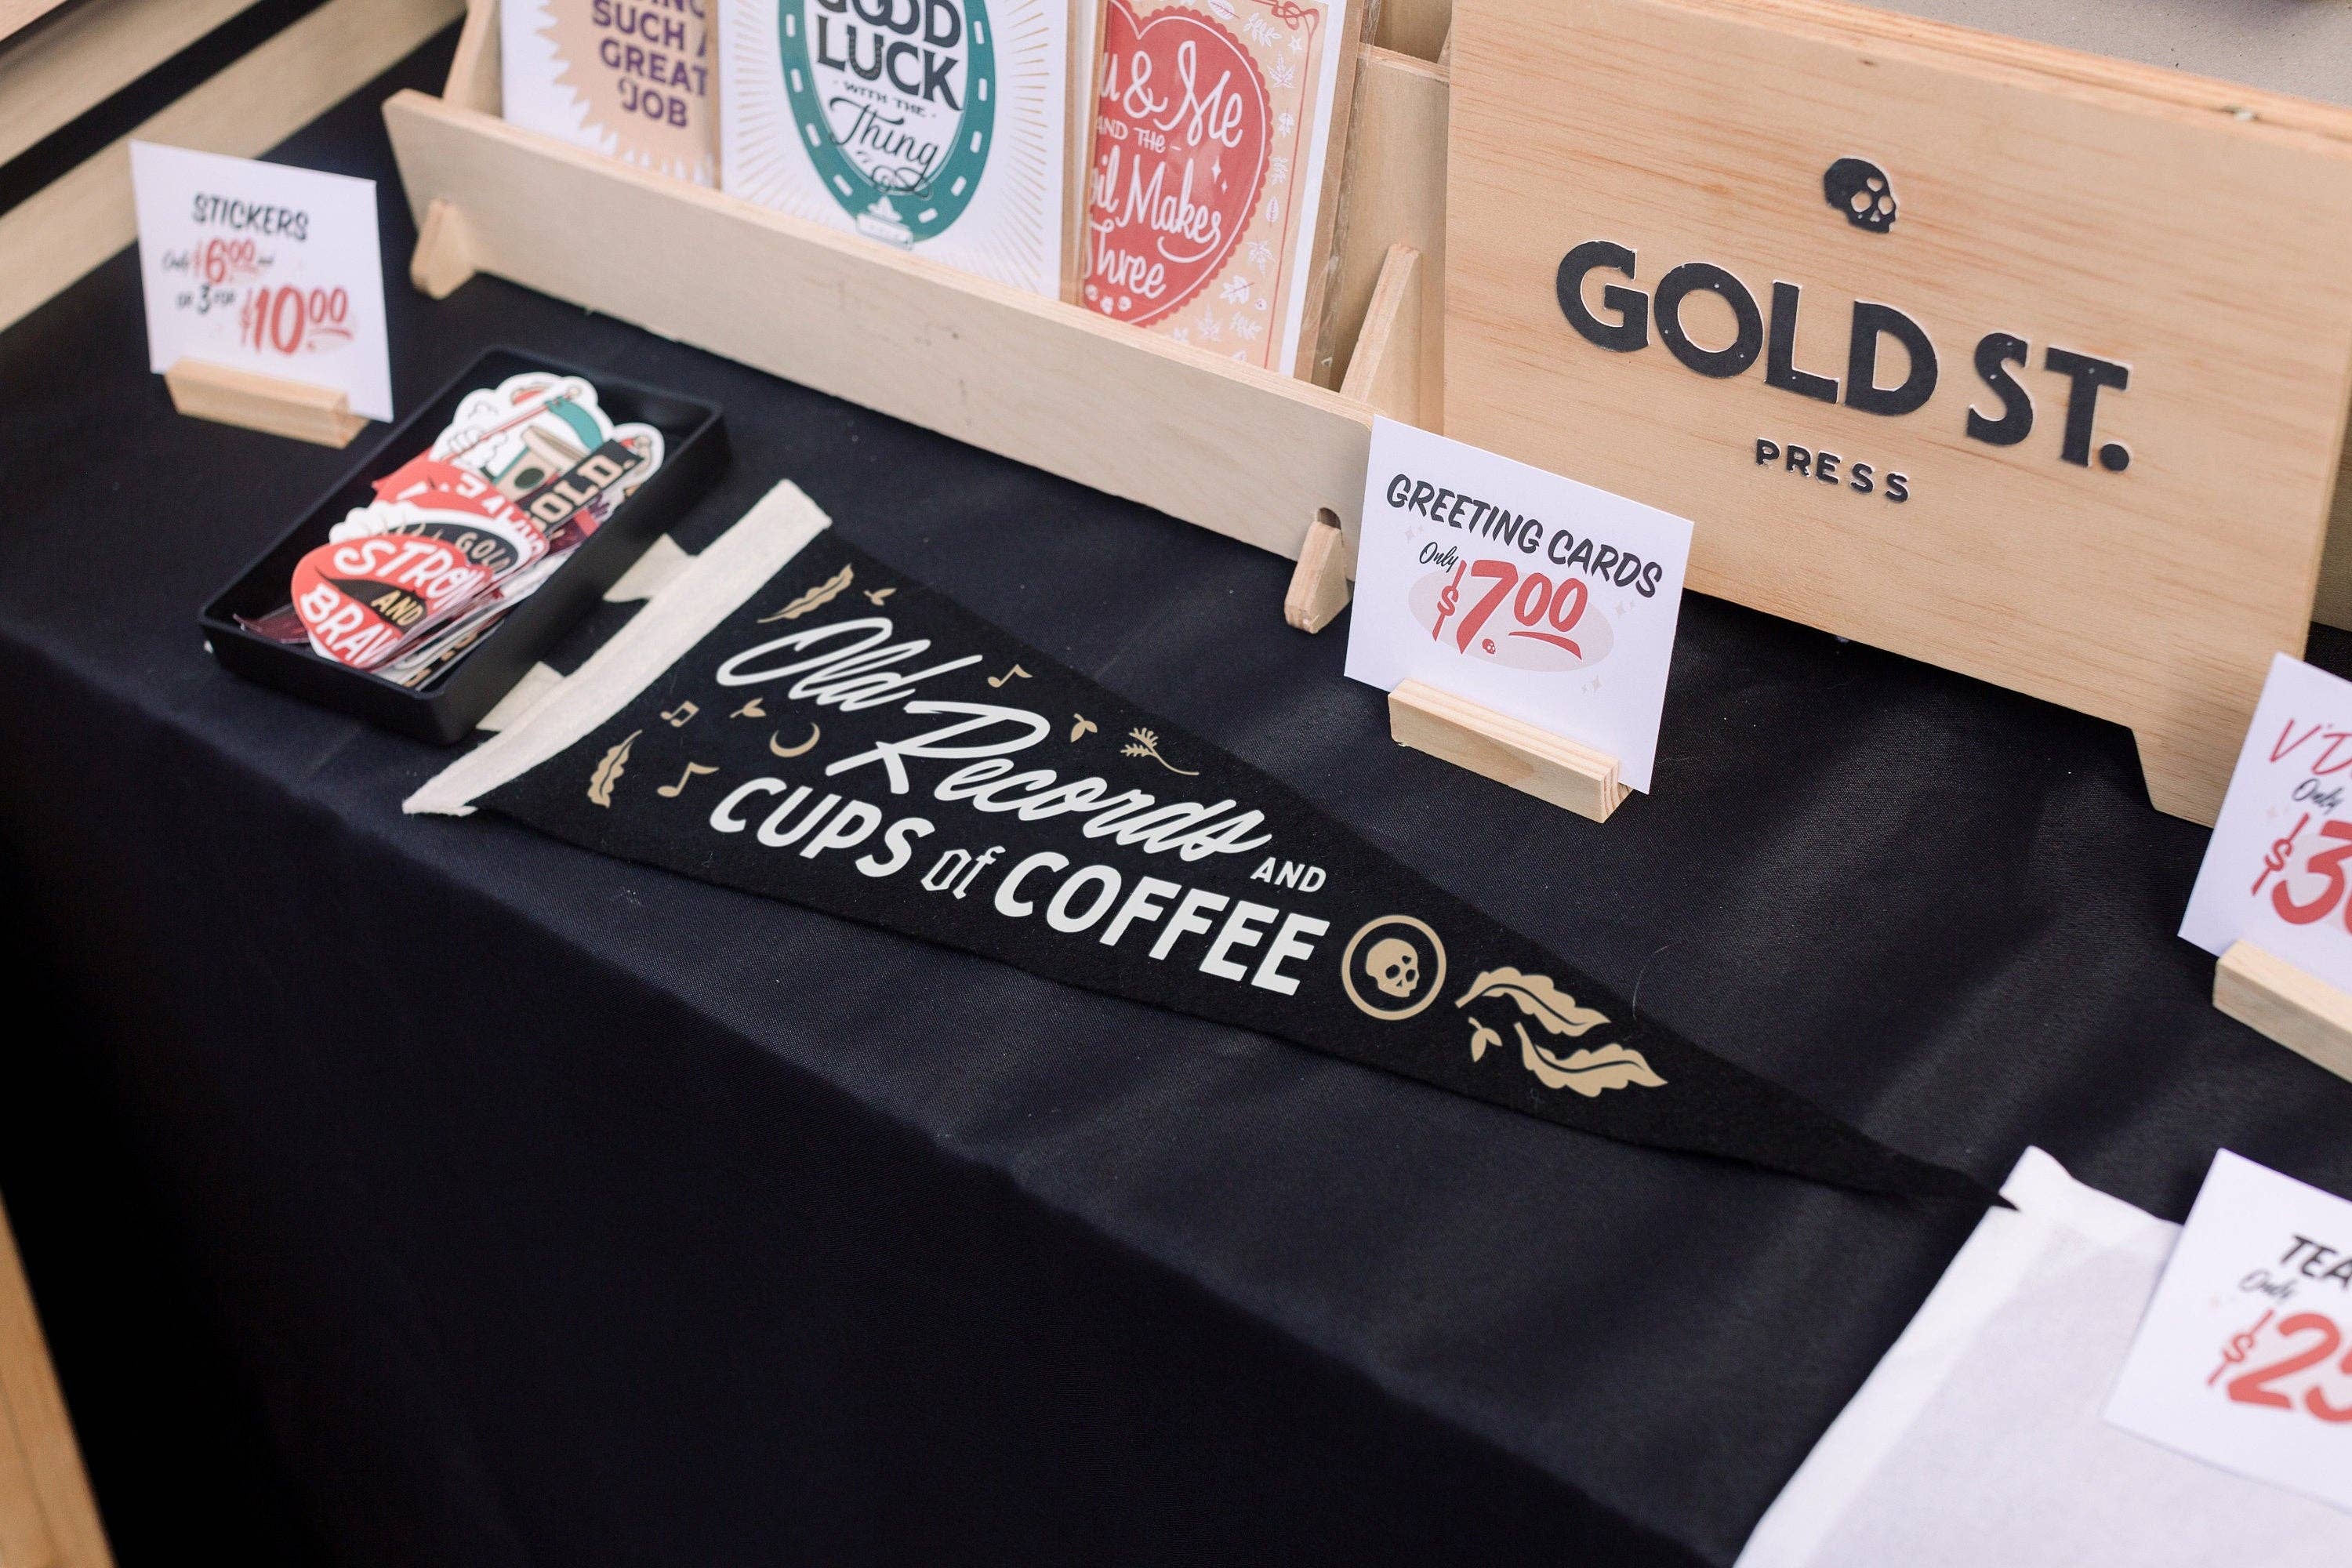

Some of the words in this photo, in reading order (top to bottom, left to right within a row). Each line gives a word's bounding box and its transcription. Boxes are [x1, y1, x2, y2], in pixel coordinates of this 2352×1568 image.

[593, 0, 684, 50] SUCH
[601, 38, 707, 96] GREAT
[818, 14, 962, 111] LUCK
[1153, 40, 1243, 147] Me
[618, 76, 687, 127] JOB
[844, 81, 887, 103] WITH
[894, 97, 927, 118] THE
[829, 97, 938, 198] Thing
[192, 194, 309, 241] STICKERS
[1116, 154, 1221, 263] Makes
[198, 283, 211, 314] 3
[1555, 239, 1940, 416] GOLD
[1966, 332, 2133, 471] ST.
[1755, 437, 1910, 503] PRESS
[1387, 474, 1543, 554] GREETING
[1548, 529, 1662, 598] CARDS
[1419, 541, 1459, 573] Only
[370, 590, 423, 626] AND
[717, 617, 983, 711] Old
[826, 701, 1272, 862] Records
[1250, 857, 1327, 892] AND
[2292, 778, 2344, 815] Only
[710, 777, 935, 877] CUPS
[921, 847, 1004, 899] of
[994, 851, 1330, 996] COFFEE
